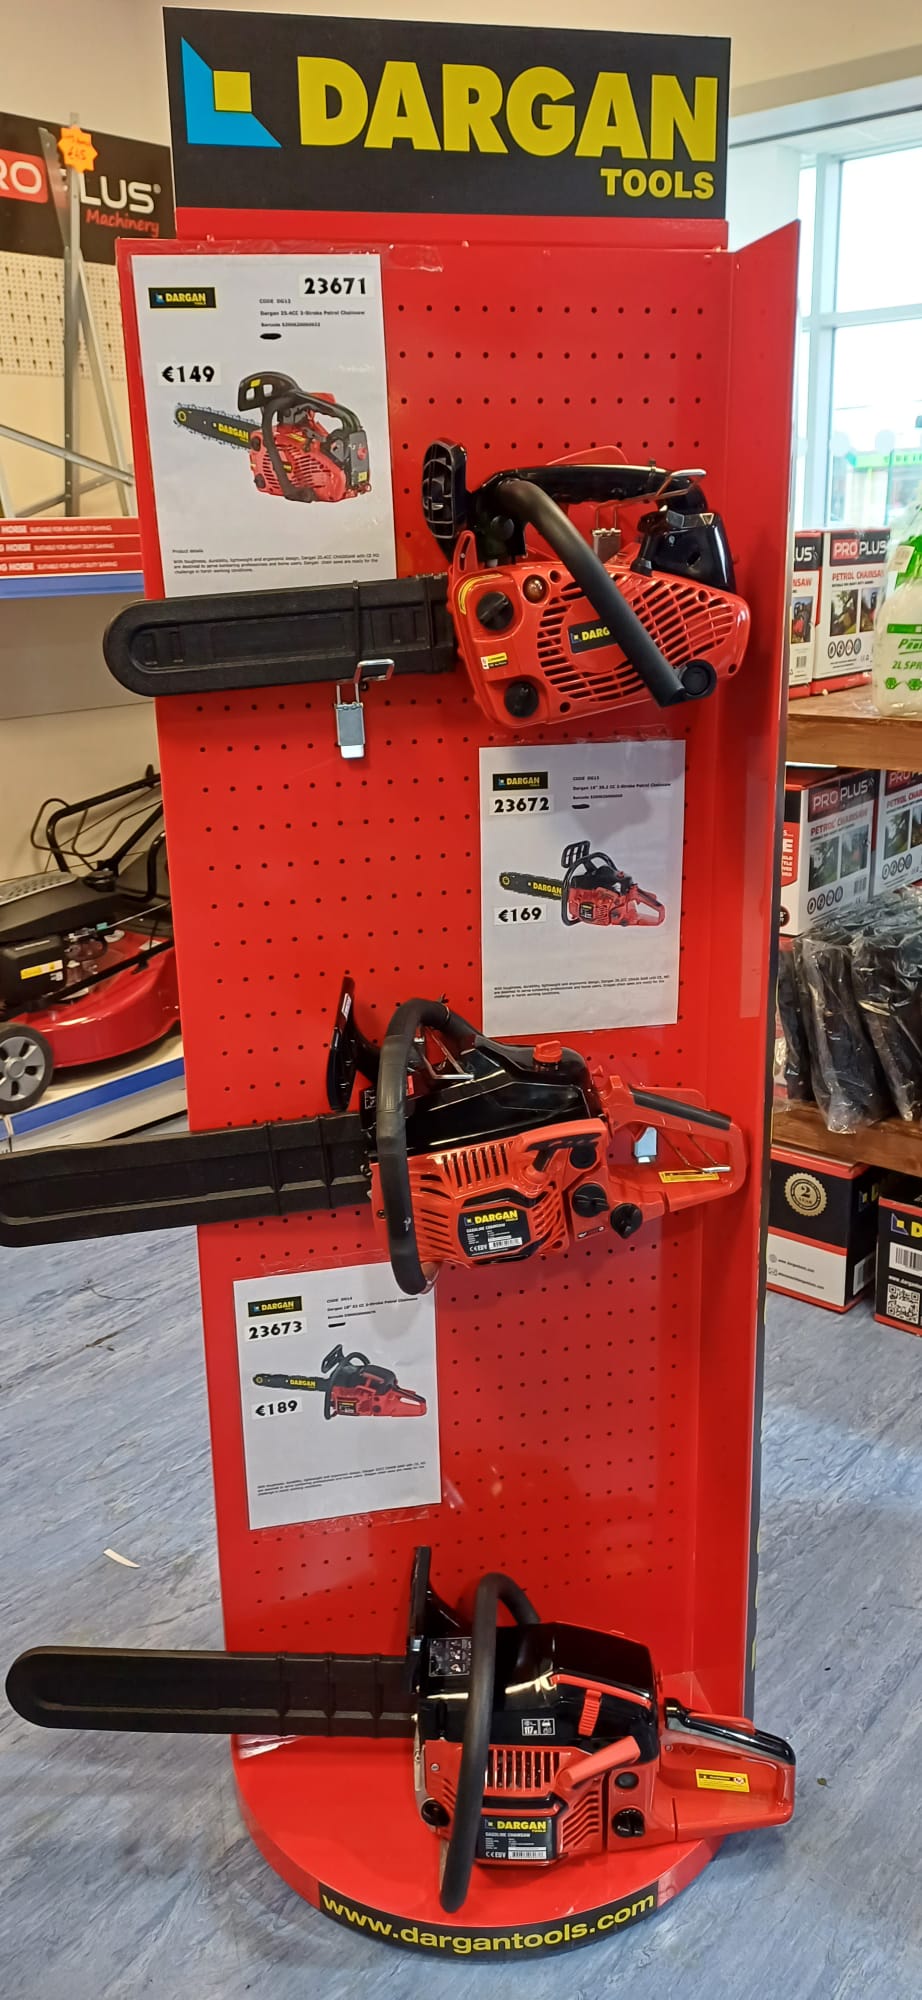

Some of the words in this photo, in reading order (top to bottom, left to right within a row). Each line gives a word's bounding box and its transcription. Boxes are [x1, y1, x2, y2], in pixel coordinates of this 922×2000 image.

[298, 56, 718, 162] DARGAN
[600, 168, 715, 199] TOOLS
[86, 209, 160, 238] Machinery
[304, 277, 366, 294] 23671
[165, 292, 206, 302] DARGAN
[162, 365, 215, 382] €149
[218, 423, 249, 442] DARGAN
[833, 541, 858, 556] PRO
[858, 540, 887, 556] PLUS
[832, 572, 855, 581] PETROL
[581, 626, 611, 641] DARG
[506, 776, 540, 786] DARGAN
[813, 790, 839, 810] PRO
[840, 779, 868, 801] PLUS
[494, 797, 550, 813] 23672
[533, 881, 562, 894] DARGAN
[499, 906, 543, 923] €169
[801, 1185, 811, 1198] 2
[475, 1209, 518, 1225] DARGAN
[261, 1300, 295, 1312] DARGAN
[248, 1320, 303, 1340] 23673
[290, 1379, 316, 1388] DARGAN
[255, 1400, 298, 1417] €189
[496, 1820, 547, 1830] DARGAN
[322, 1894, 655, 1955] www.dargantools.com
